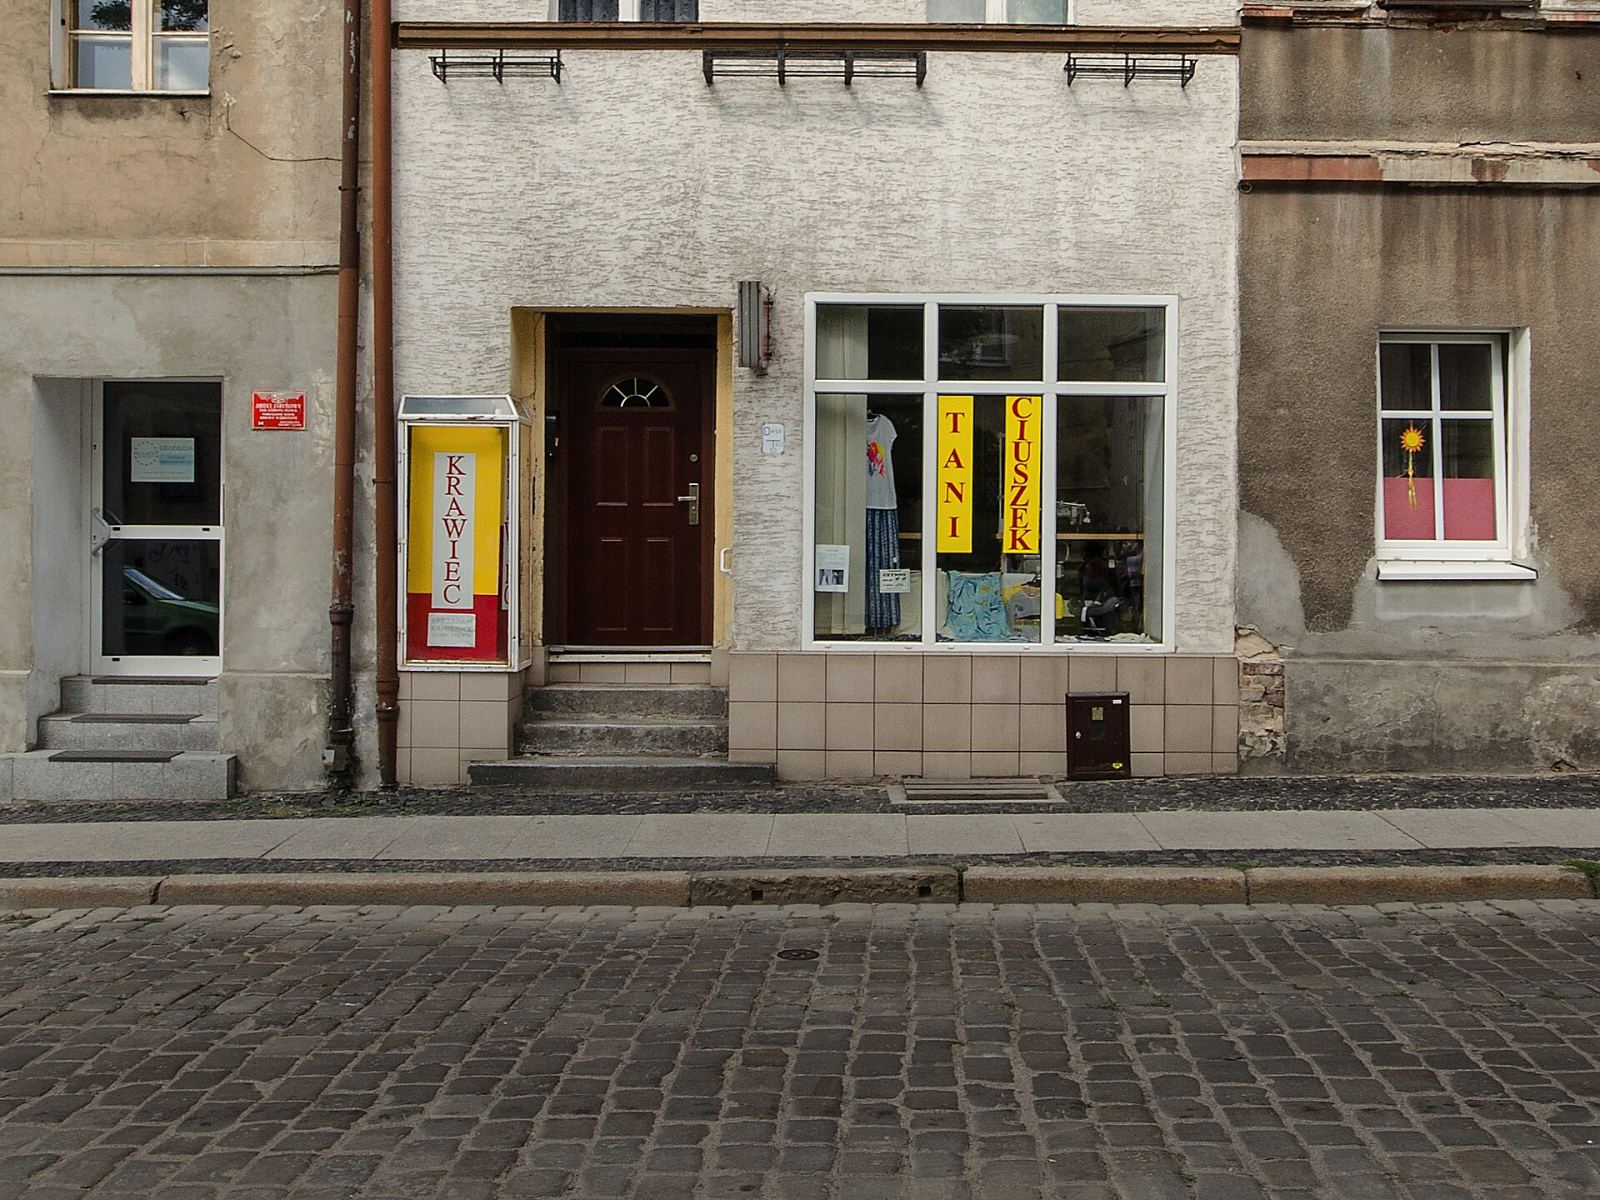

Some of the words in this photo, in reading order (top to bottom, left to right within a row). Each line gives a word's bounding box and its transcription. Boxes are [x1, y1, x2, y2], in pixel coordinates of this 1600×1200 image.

[442, 455, 468, 604] KRAWIEC
[943, 412, 965, 538] TANI
[1009, 397, 1033, 551] CIUSZEK
